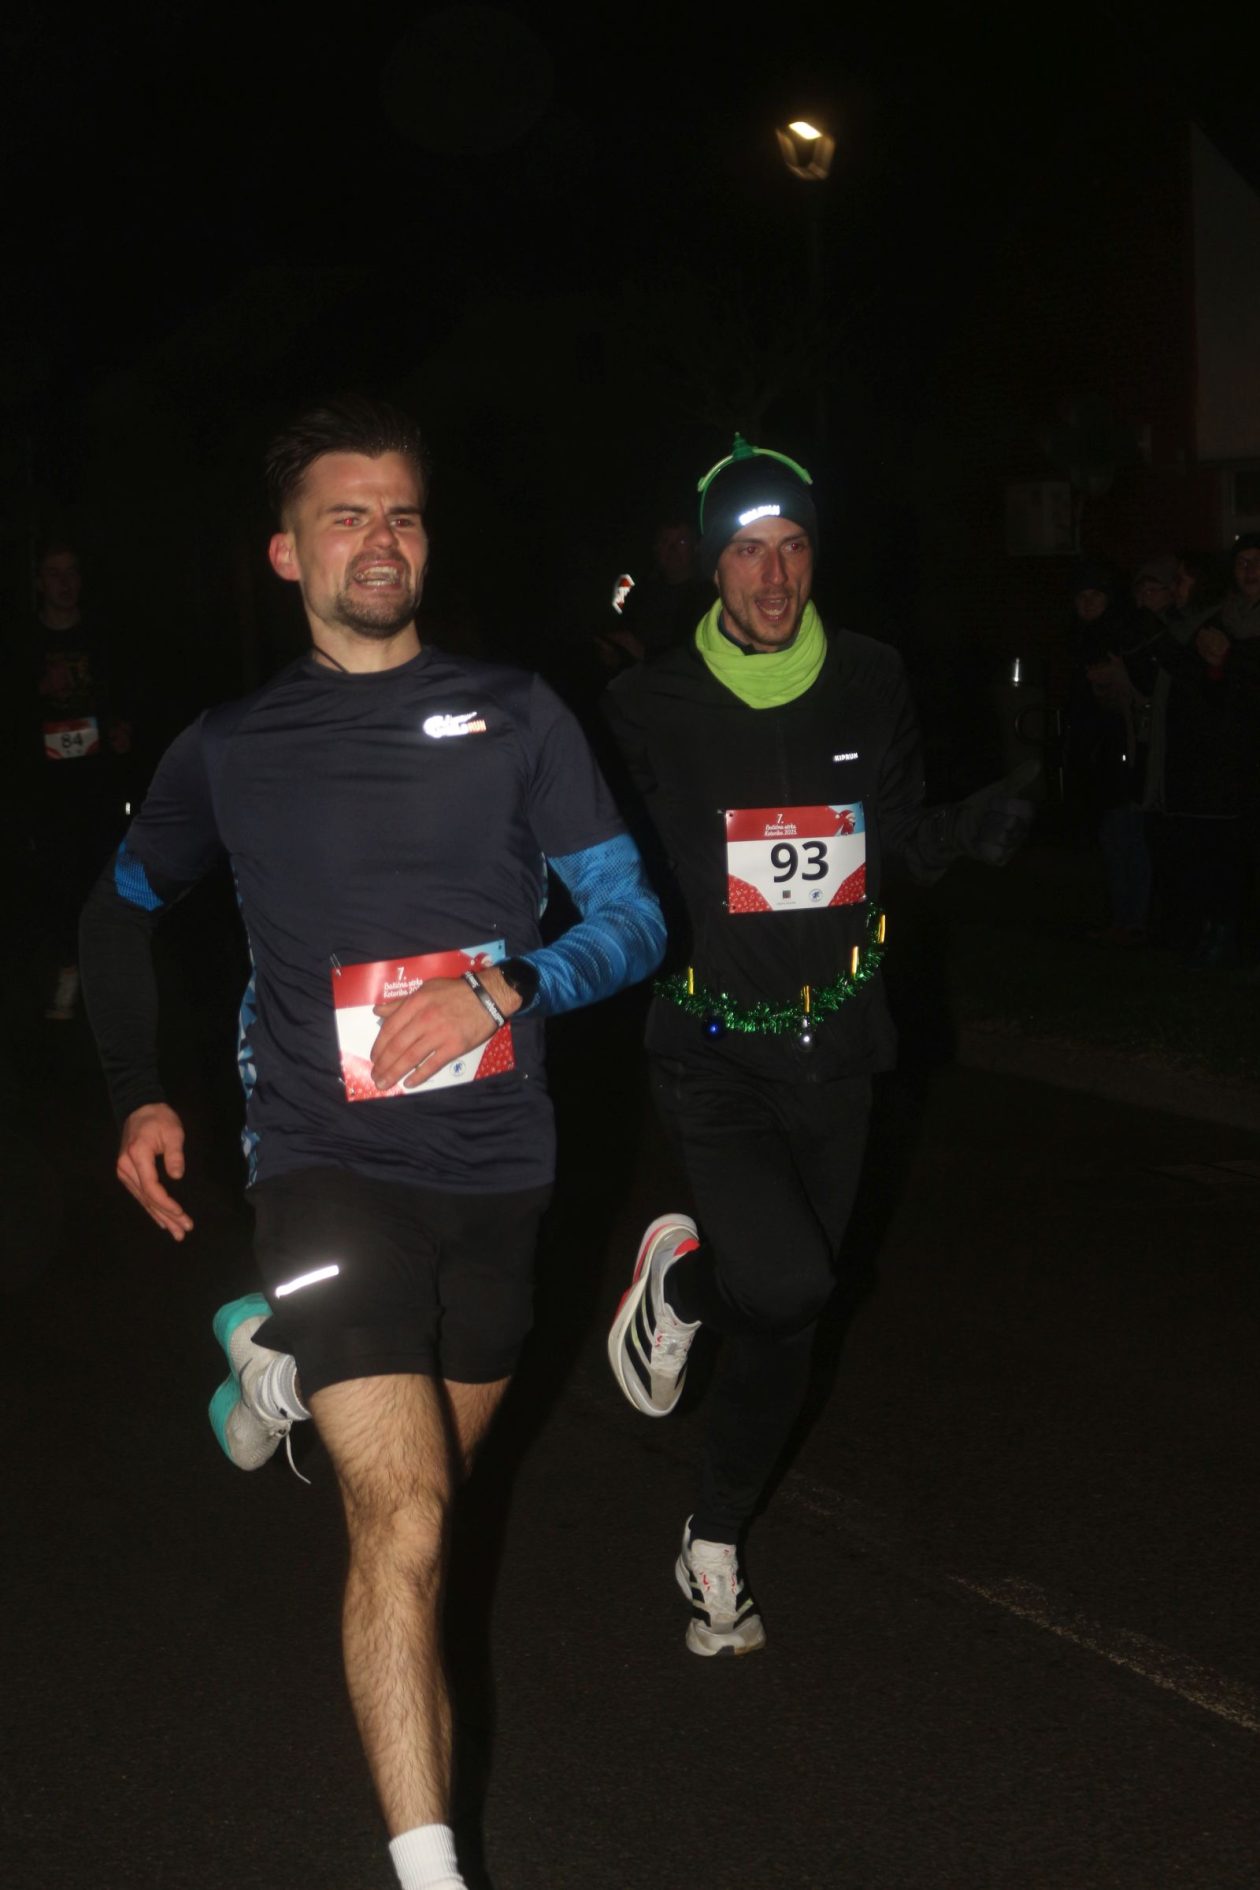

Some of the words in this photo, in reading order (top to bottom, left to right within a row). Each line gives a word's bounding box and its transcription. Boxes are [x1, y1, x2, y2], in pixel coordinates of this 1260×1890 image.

[777, 813, 784, 824] 7.
[770, 840, 830, 883] 93
[397, 967, 407, 981] 7.
